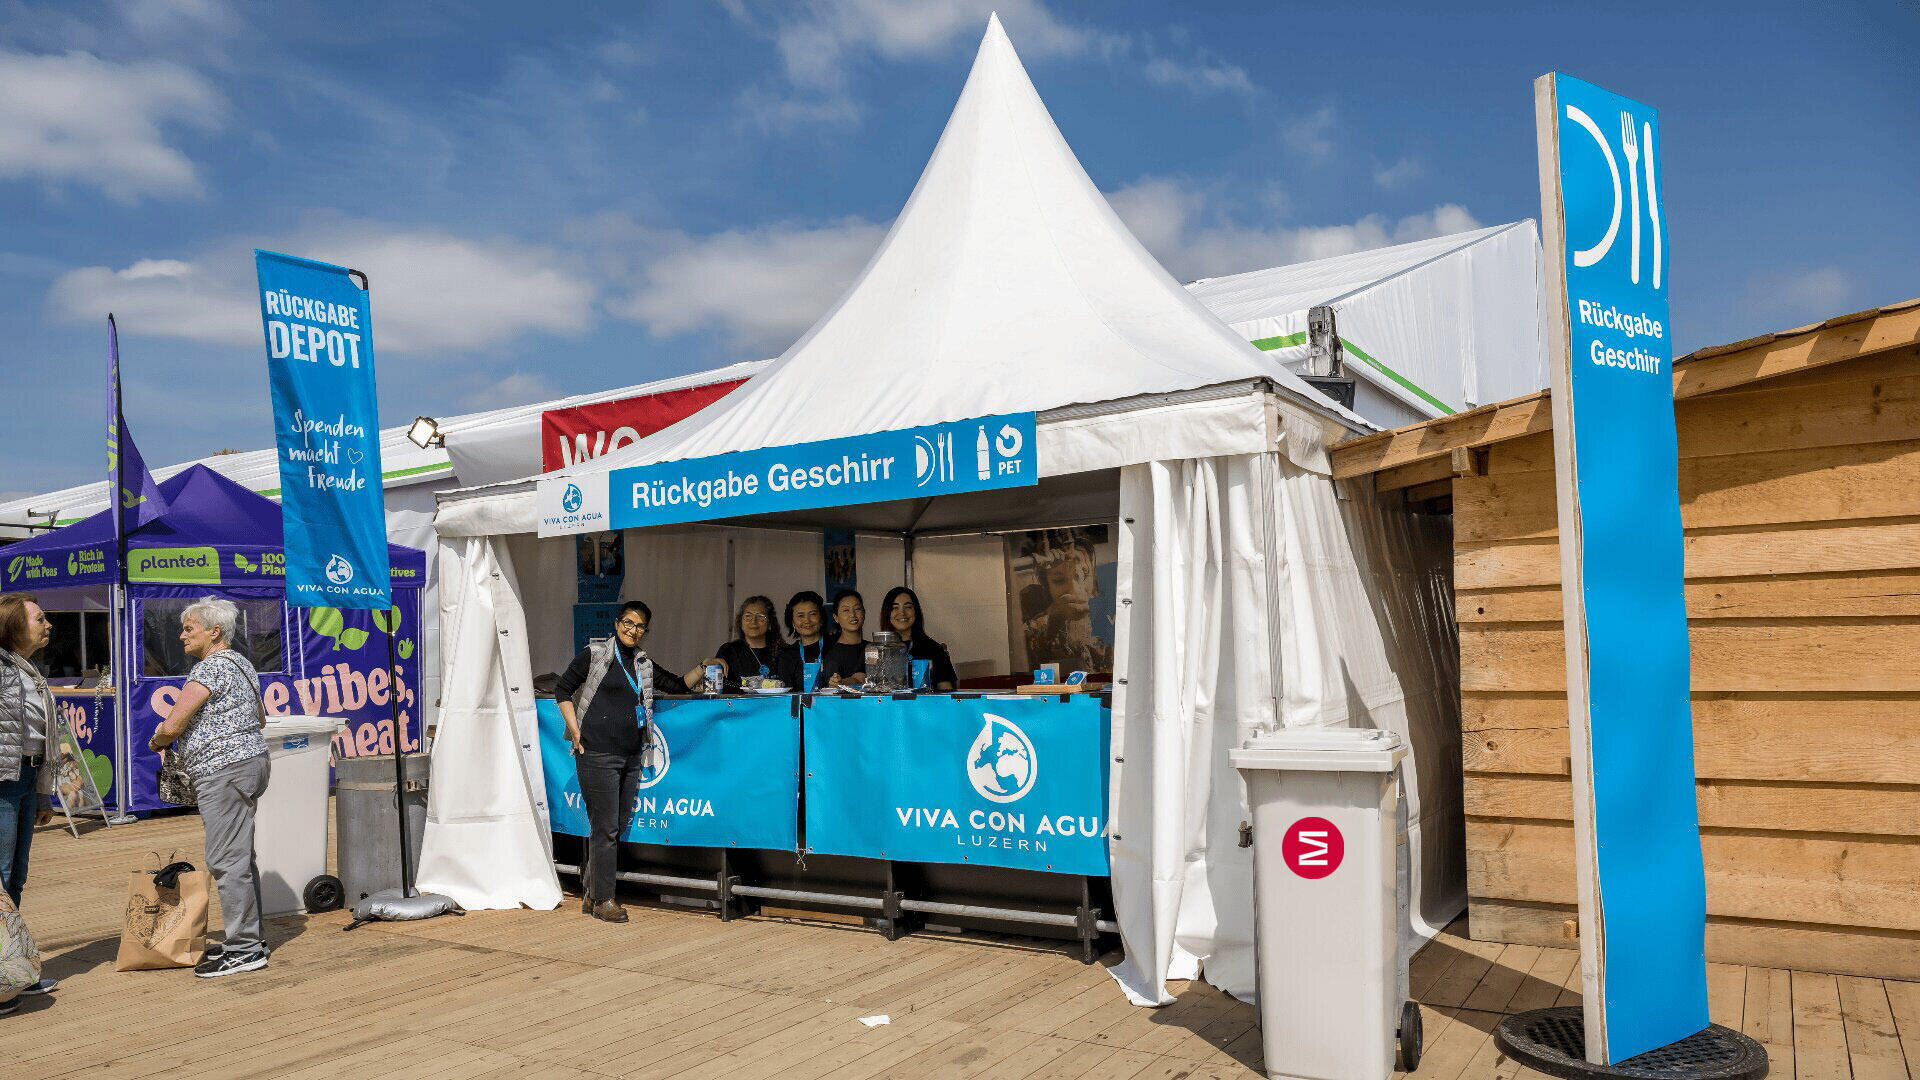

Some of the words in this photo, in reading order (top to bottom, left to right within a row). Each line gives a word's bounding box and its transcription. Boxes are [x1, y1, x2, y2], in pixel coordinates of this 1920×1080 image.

[265, 288, 360, 329] RÜCKGABE
[1578, 299, 1663, 339] Rückgabe
[268, 320, 361, 369] DEPOT
[1590, 339, 1660, 375] Geschirr
[290, 408, 364, 448] Spenden
[288, 438, 341, 464] macht
[631, 470, 759, 509] Rückgabe
[767, 452, 895, 492] Geschirr
[998, 459, 1022, 476] PET
[562, 514, 579, 523] CON
[581, 511, 602, 521] AGUA
[140, 554, 210, 572] planted.
[296, 584, 324, 593] VIVA
[326, 585, 350, 595] CON
[352, 586, 385, 597] AGUA
[662, 797, 715, 817] AGUA
[896, 807, 960, 829] VIVA
[968, 809, 1026, 834] CON
[957, 834, 1047, 852] LUZERN
